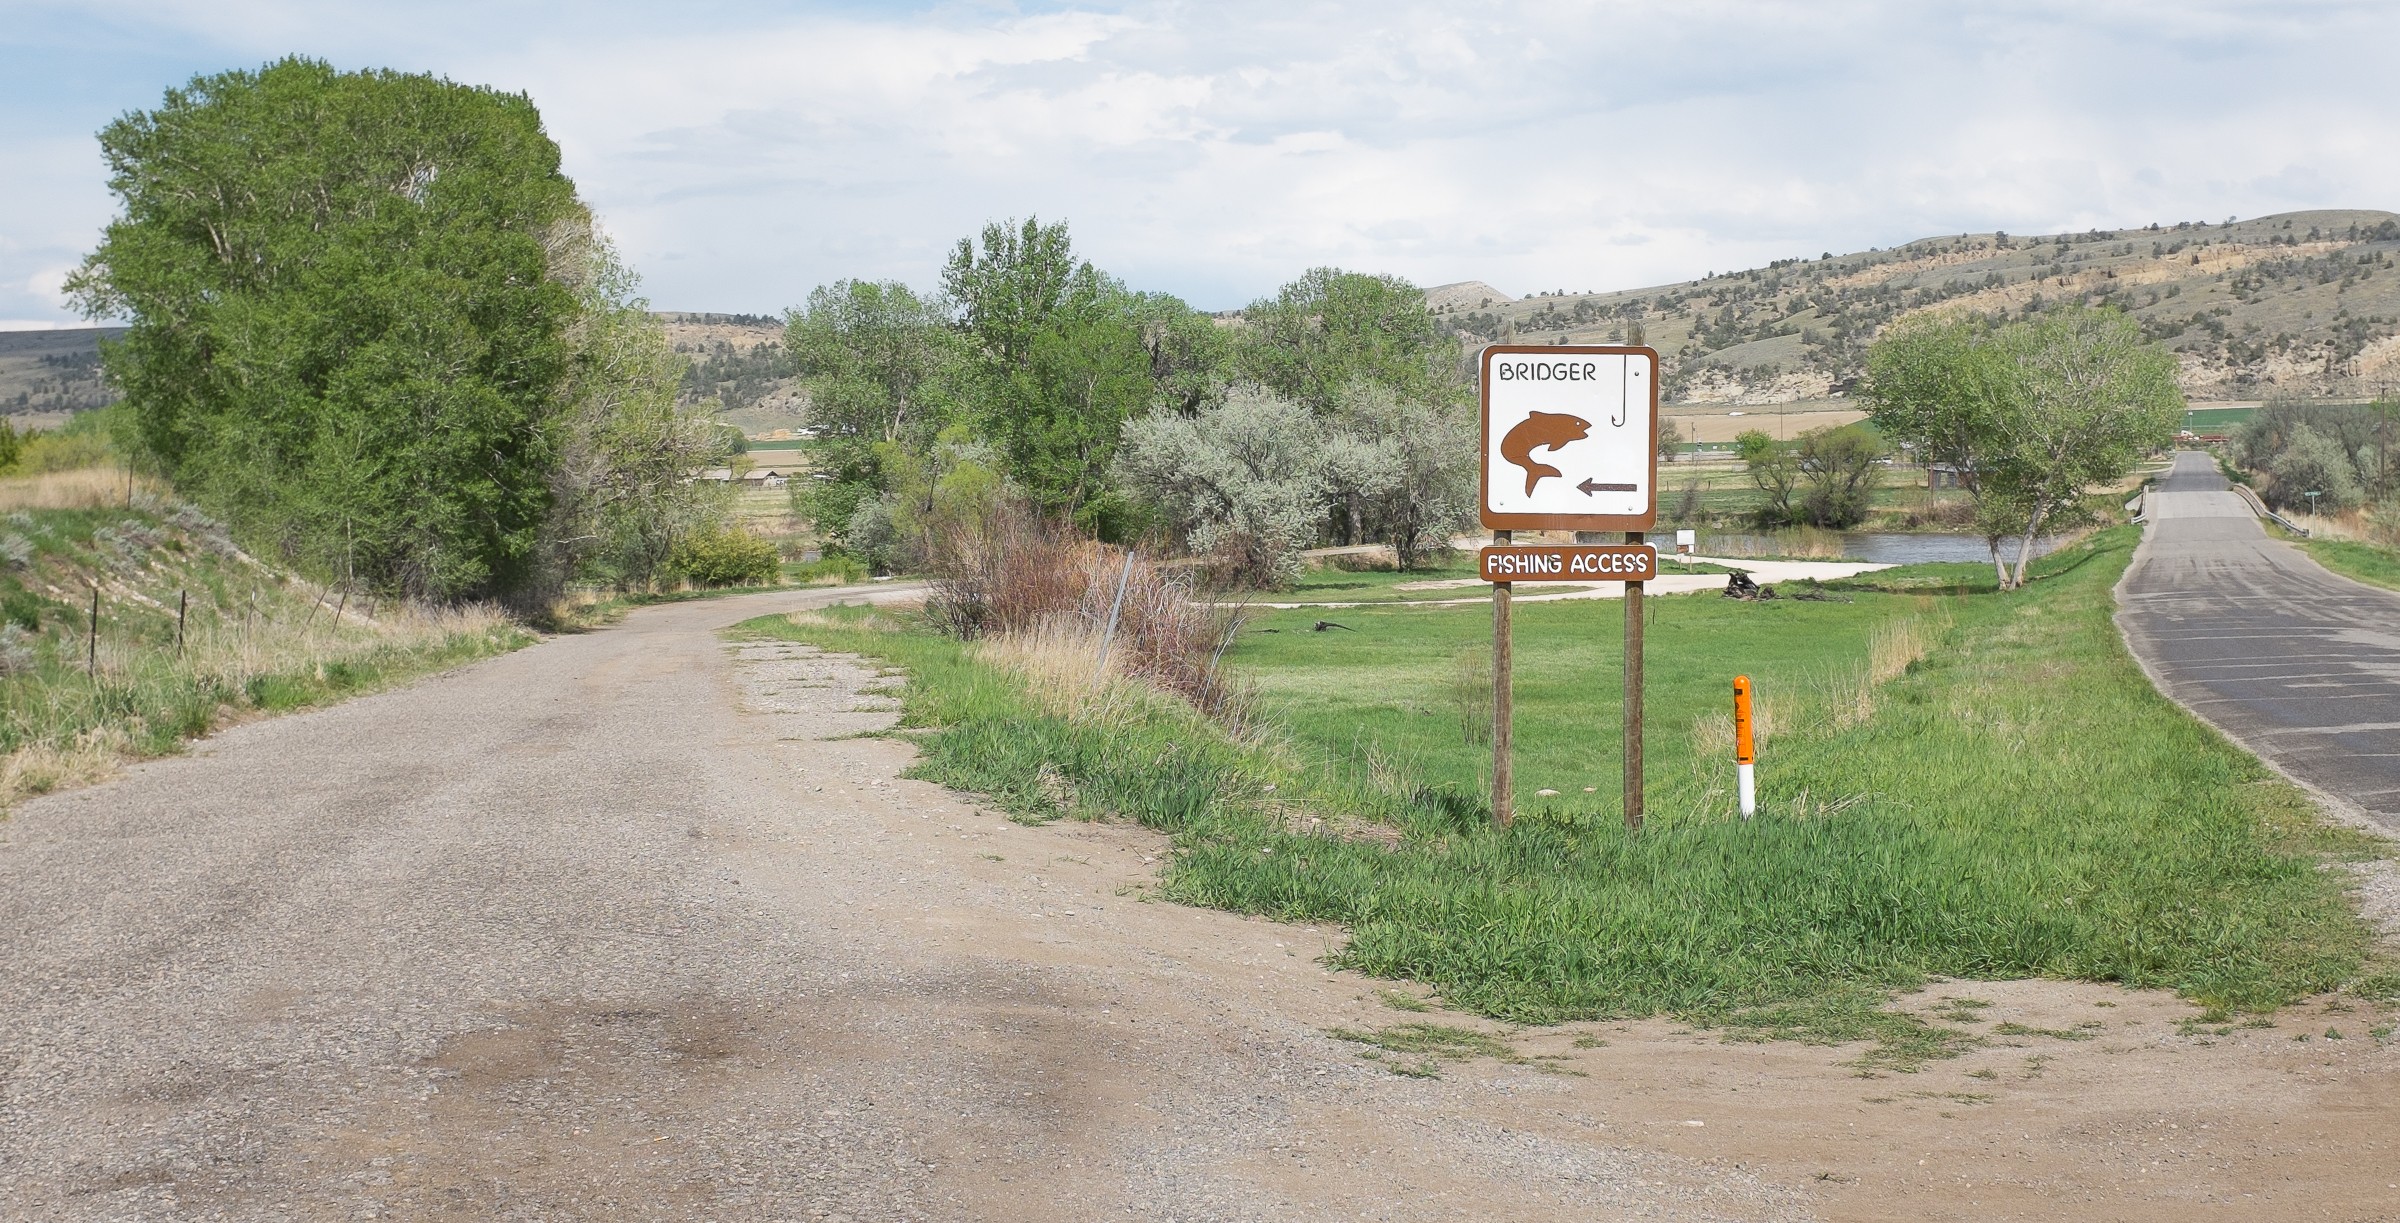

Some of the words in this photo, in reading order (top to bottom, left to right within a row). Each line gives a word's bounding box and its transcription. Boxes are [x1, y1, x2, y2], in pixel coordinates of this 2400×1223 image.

[1499, 362, 1596, 381] BRIDGER
[1487, 553, 1562, 574] FISHING
[1570, 553, 1649, 573] ACCESS
